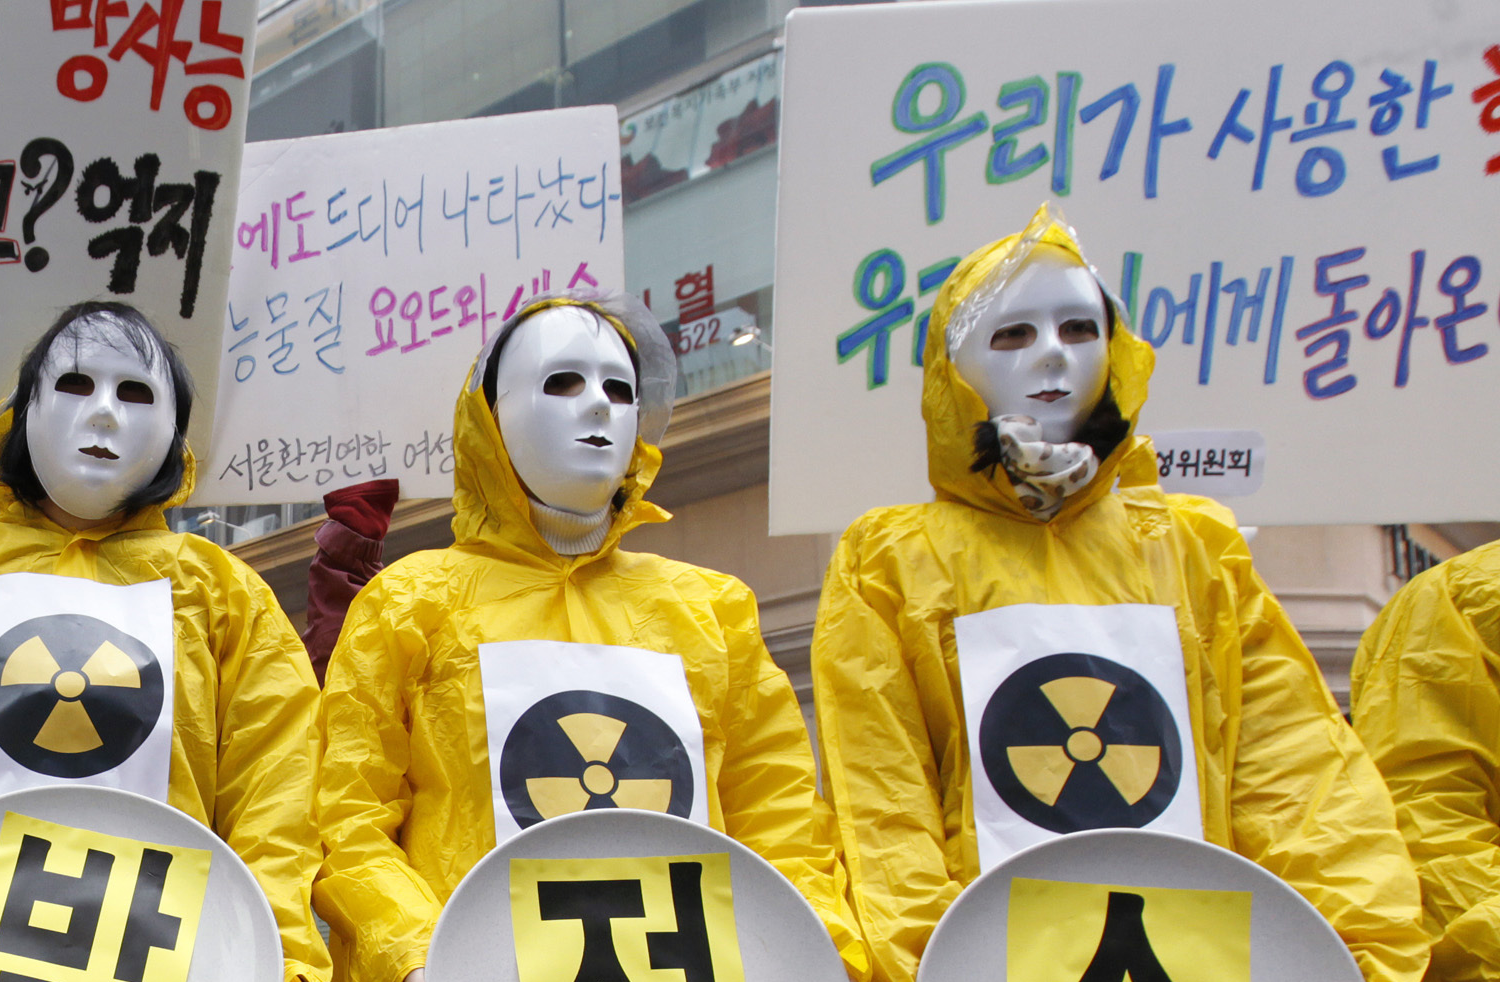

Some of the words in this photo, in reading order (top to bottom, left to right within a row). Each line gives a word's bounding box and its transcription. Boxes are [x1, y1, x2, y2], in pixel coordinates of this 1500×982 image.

[870, 61, 1192, 225] 우리가
[1207, 60, 1453, 197] 사용한
[74, 153, 222, 319] 억지
[326, 174, 424, 257] 드디어
[442, 158, 621, 260] 나타났다
[365, 272, 497, 357] 요오드와
[219, 430, 392, 491] 서울환경연합
